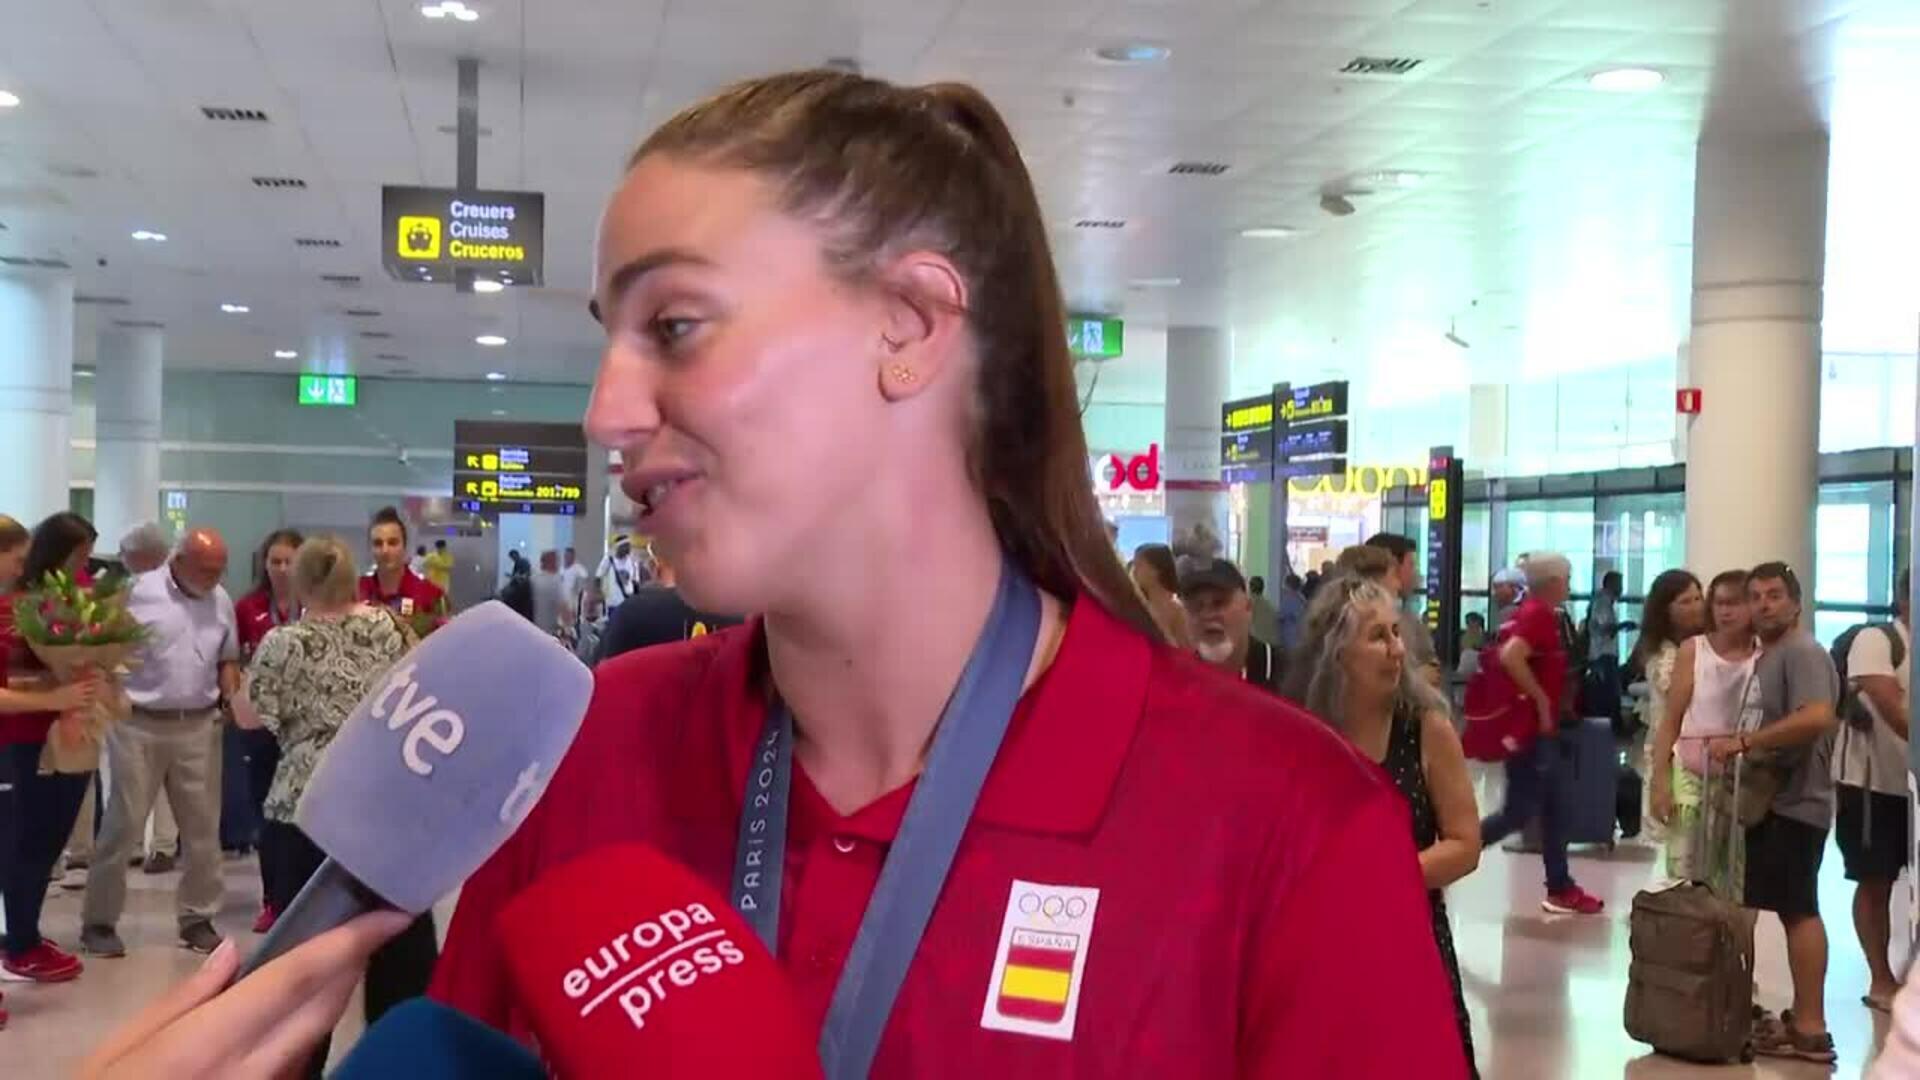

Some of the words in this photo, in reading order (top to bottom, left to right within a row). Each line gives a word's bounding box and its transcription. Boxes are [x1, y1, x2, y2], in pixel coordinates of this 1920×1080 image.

[449, 240, 525, 260] Cruceros
[450, 200, 516, 220] Creuers
[450, 220, 509, 239] Cruises
[371, 663, 465, 776] tve
[740, 818, 766, 910] PARIS
[563, 902, 716, 998] europa
[618, 939, 745, 1030] press
